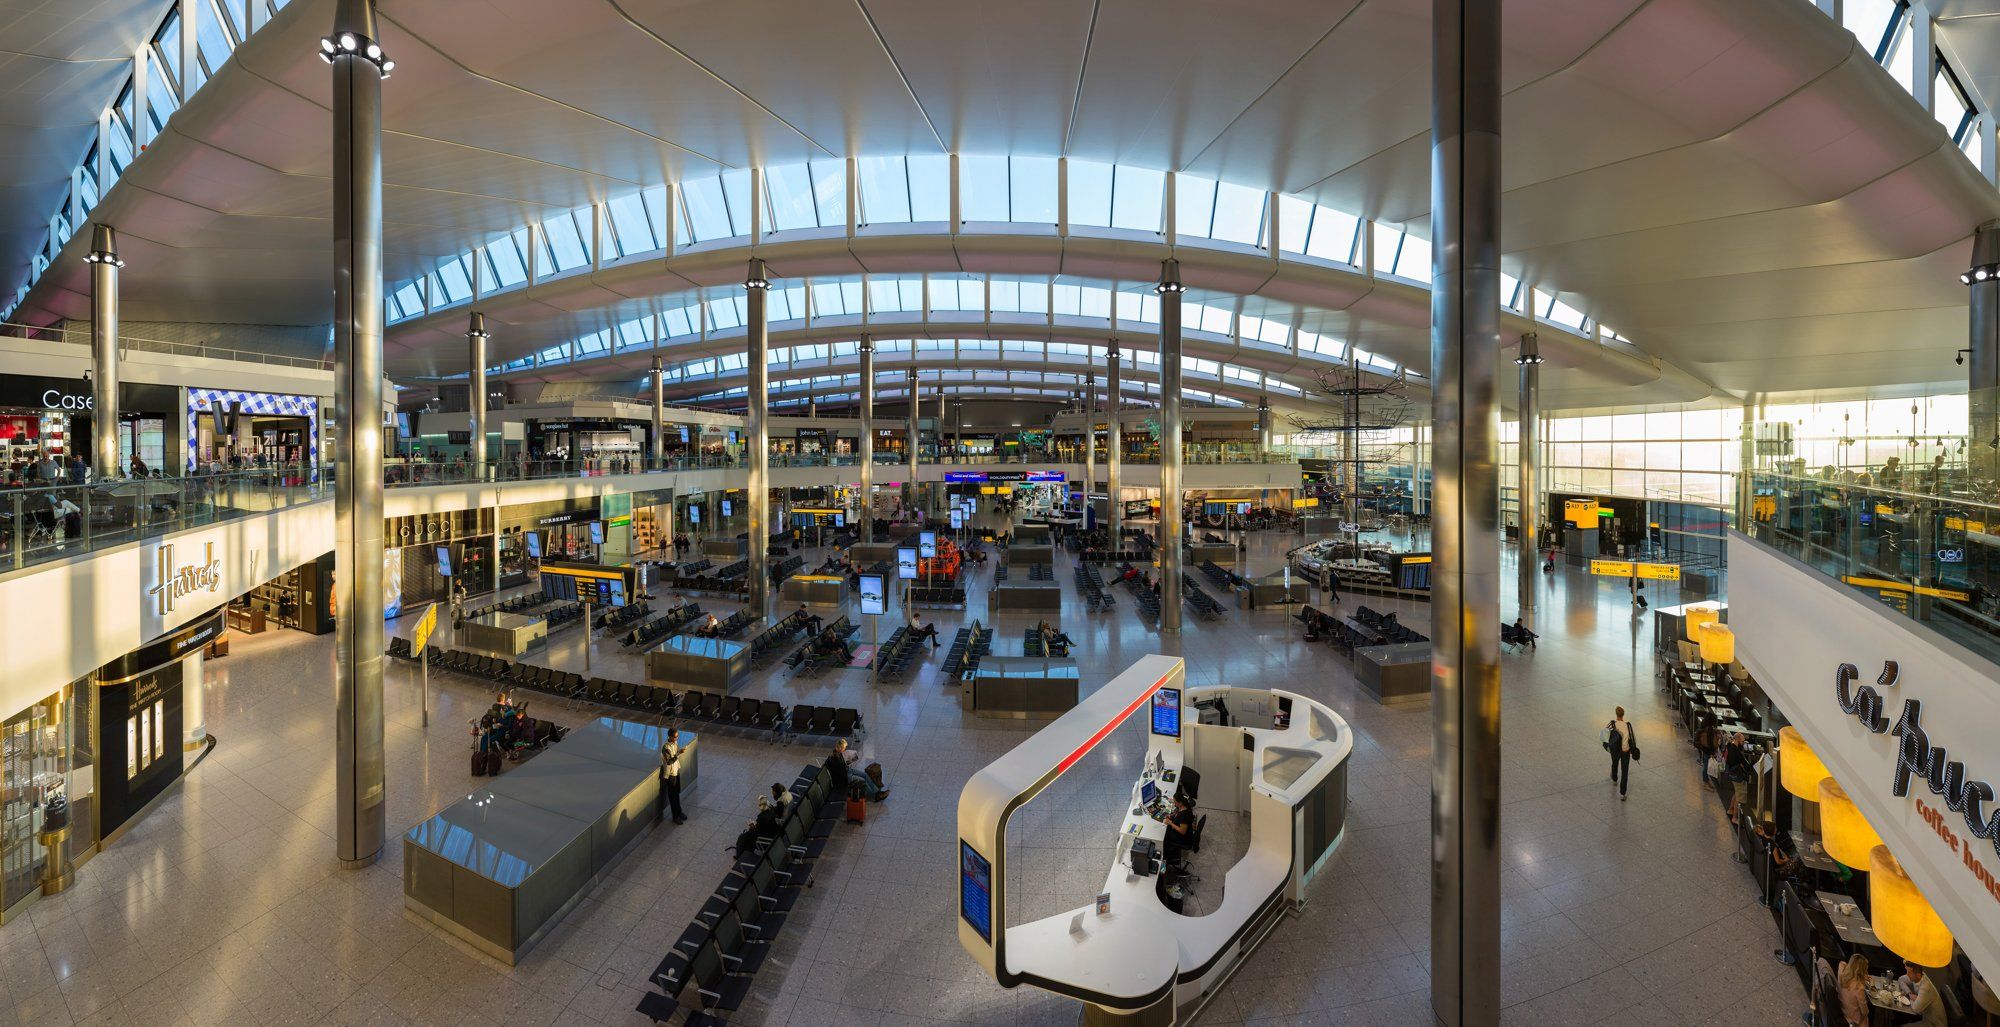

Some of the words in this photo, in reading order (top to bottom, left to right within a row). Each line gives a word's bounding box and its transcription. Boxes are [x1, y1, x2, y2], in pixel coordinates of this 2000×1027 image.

[400, 520, 455, 537] GUCCI
[540, 515, 571, 524] BURBERRY
[149, 541, 220, 615] Harrods
[133, 674, 158, 701] Harrods
[1916, 798, 1959, 852] coffee
